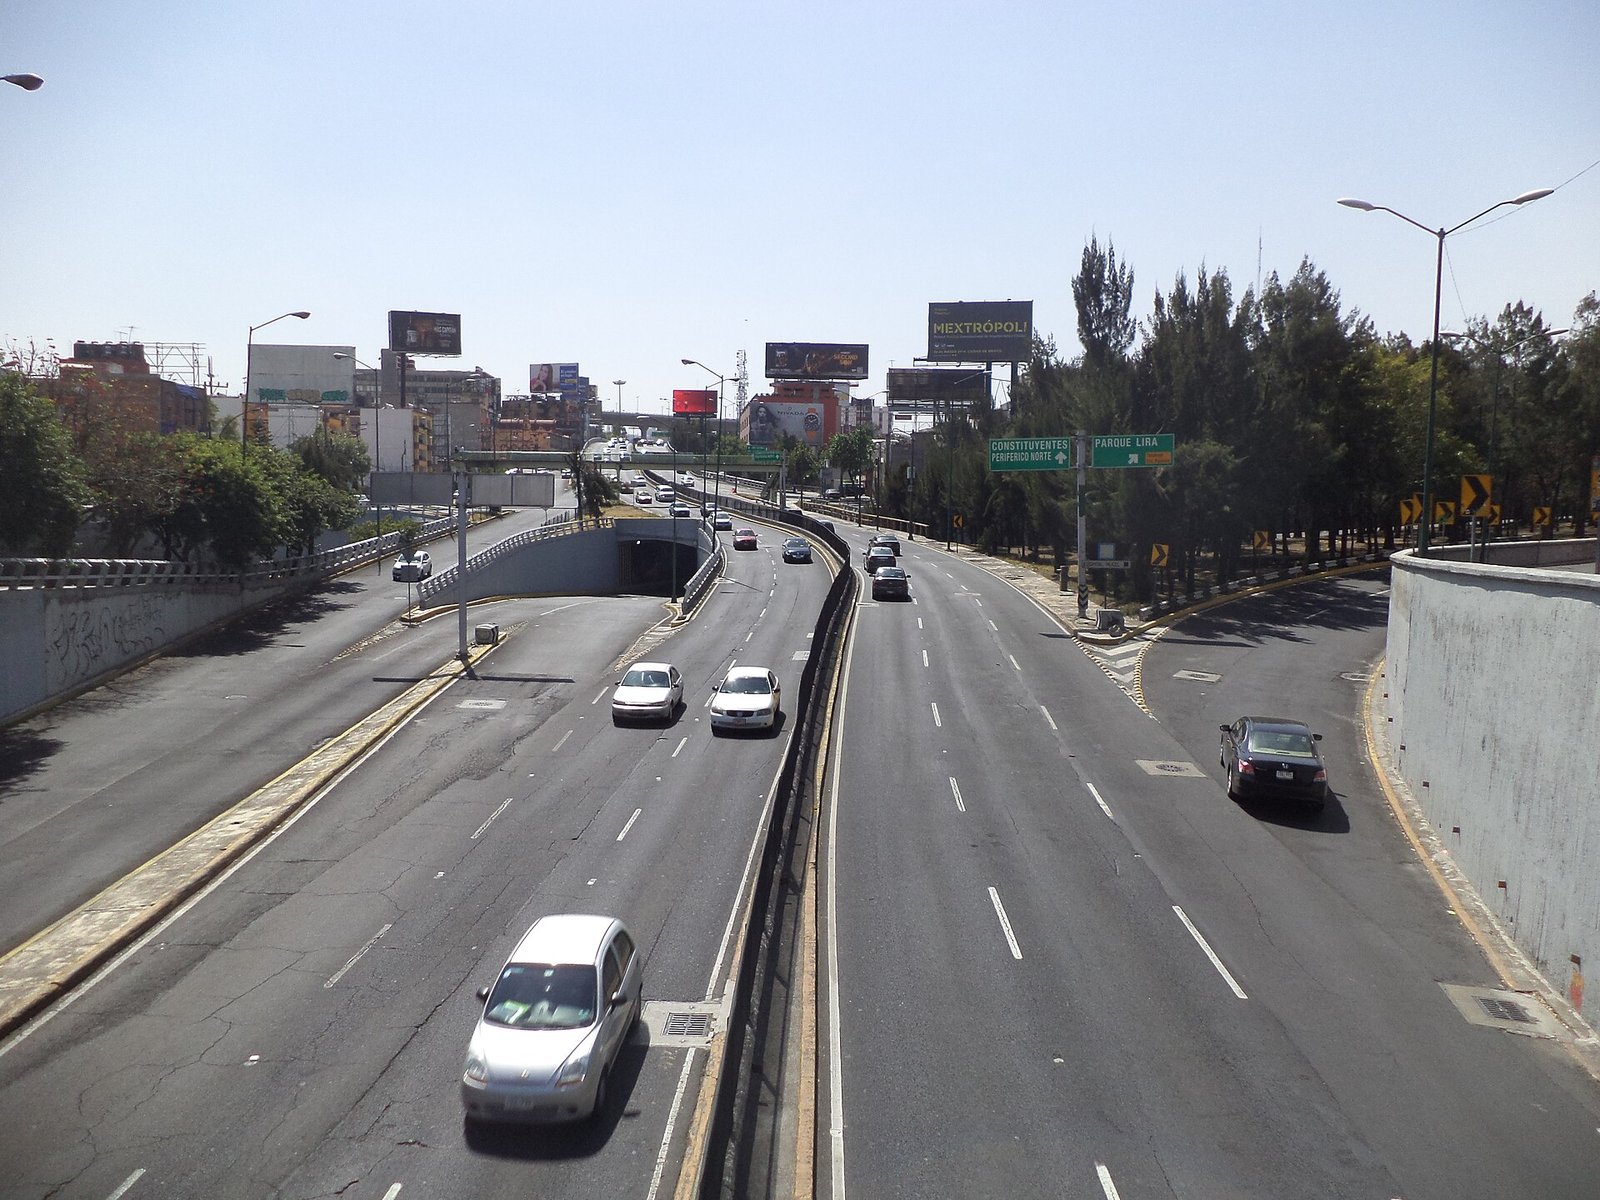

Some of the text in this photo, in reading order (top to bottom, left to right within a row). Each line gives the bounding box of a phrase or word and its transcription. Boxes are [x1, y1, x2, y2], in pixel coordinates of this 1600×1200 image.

[991, 440, 1068, 451] CONSTITUYENTES
[1095, 437, 1158, 448] PARQUE LIRA
[991, 451, 1052, 462] PERIFERICO NORTE
